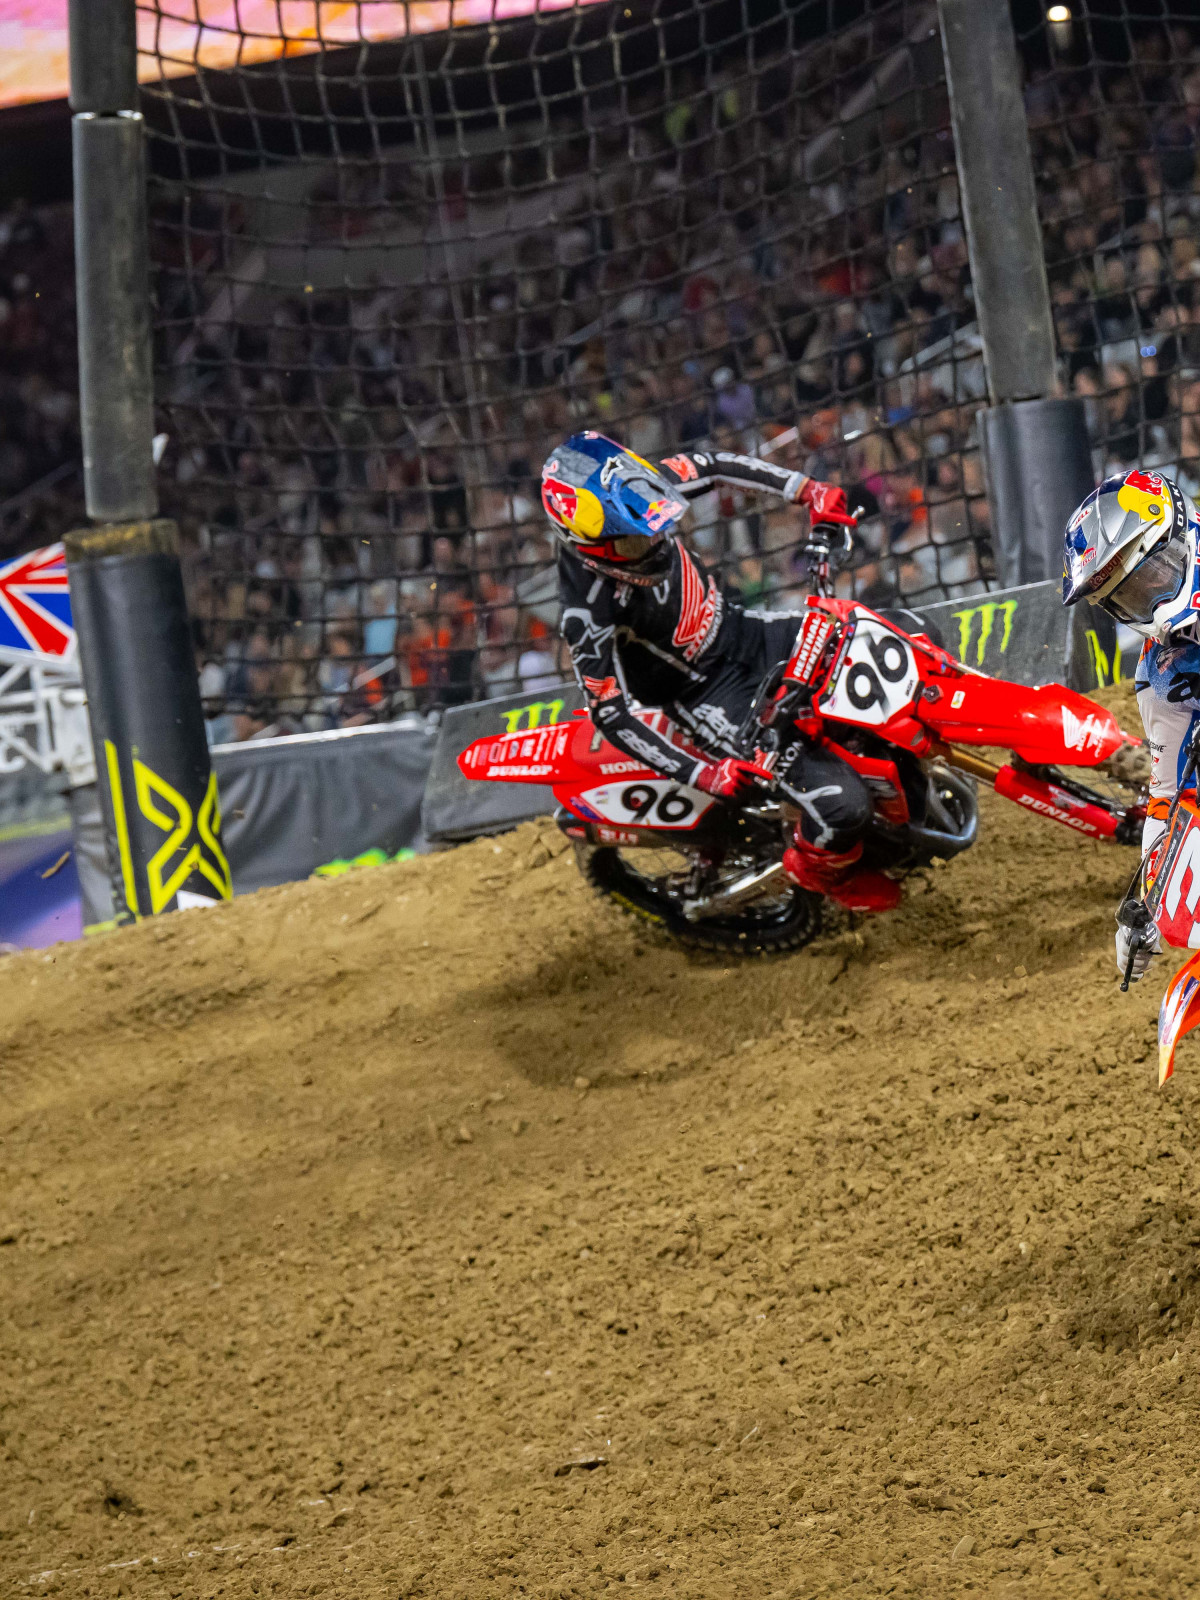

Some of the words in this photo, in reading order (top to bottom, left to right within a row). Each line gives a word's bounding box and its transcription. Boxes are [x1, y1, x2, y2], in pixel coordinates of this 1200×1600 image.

[793, 615, 821, 678] RENTHAL
[846, 631, 908, 716] 96
[486, 765, 553, 777] DUNLOP
[621, 784, 694, 823] 96
[1017, 793, 1098, 832] DUNLOP
